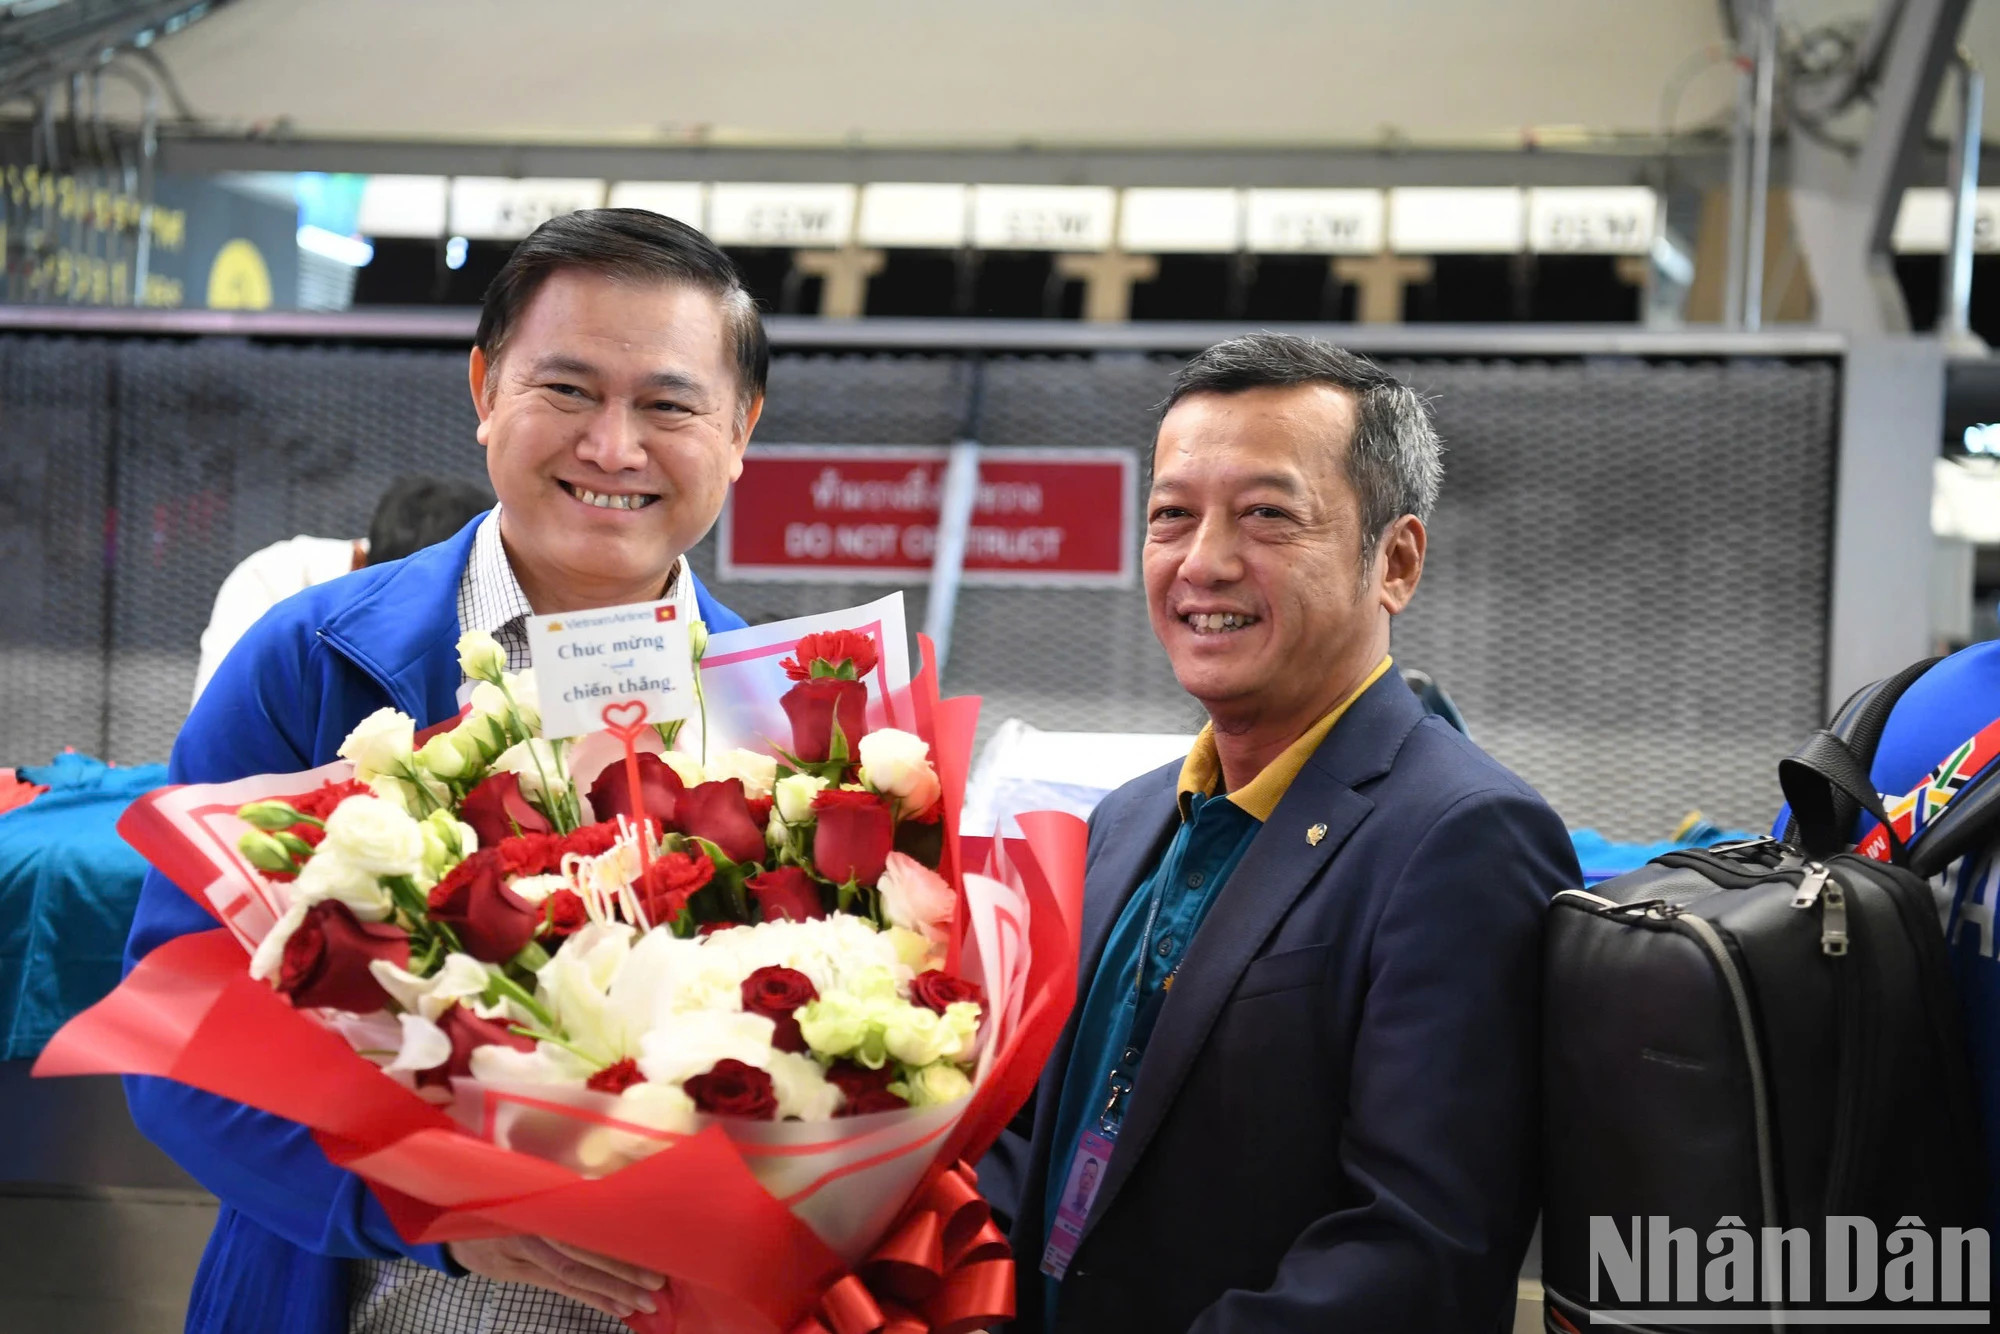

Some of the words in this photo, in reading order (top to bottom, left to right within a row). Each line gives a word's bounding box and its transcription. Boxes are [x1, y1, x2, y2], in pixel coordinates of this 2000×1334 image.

[784, 522, 832, 559] DO
[835, 523, 900, 560] NOT
[902, 525, 1064, 562] OTRUCT
[557, 640, 606, 660] Chúc
[612, 635, 665, 652] mừng
[563, 682, 612, 703] chiến
